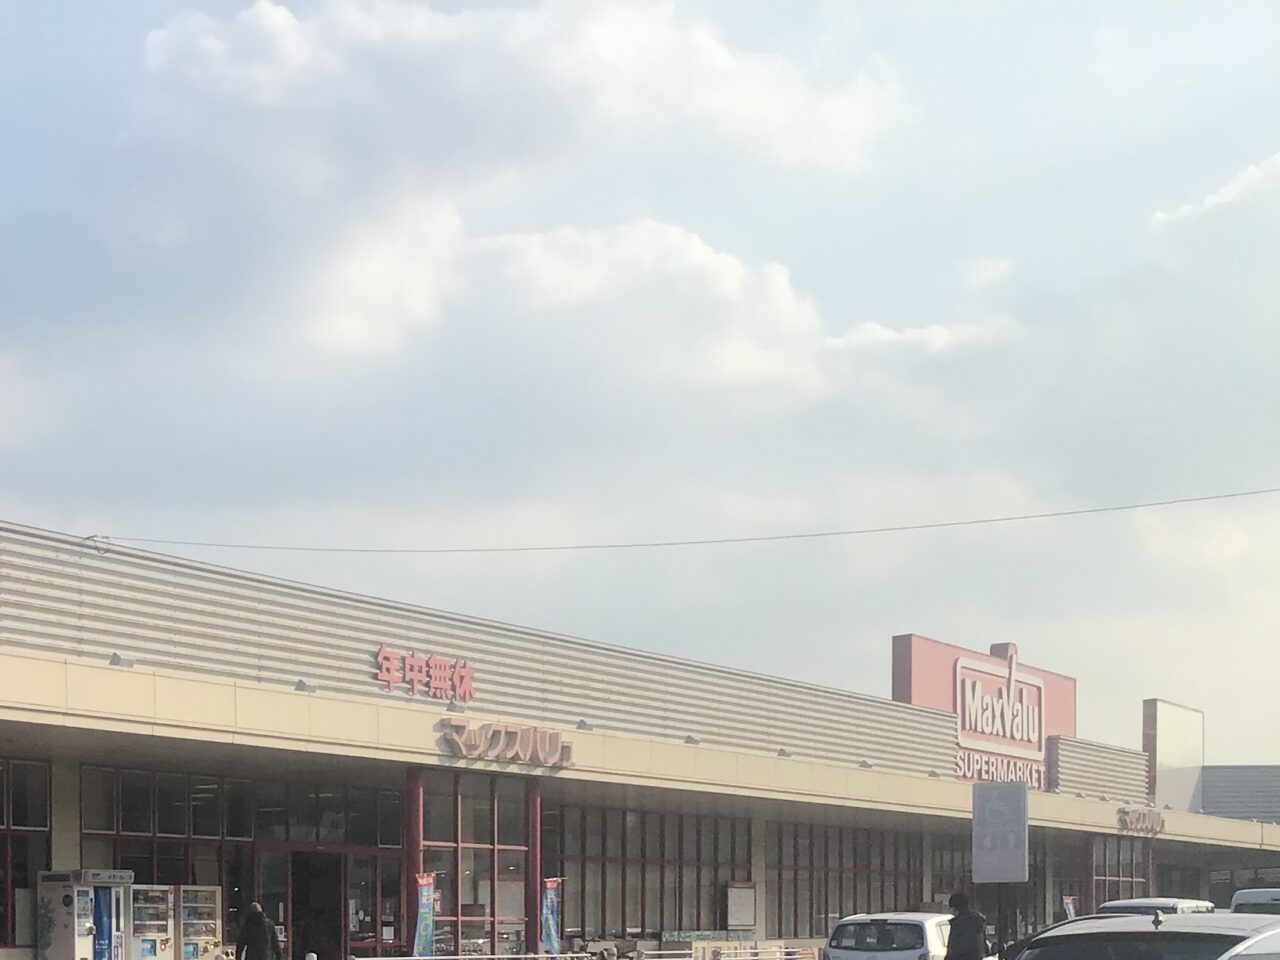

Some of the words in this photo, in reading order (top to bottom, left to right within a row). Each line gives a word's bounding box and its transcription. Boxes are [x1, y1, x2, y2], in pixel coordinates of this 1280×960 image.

[377, 642, 476, 703] 年中無休
[963, 654, 1039, 743] MaxValu
[443, 717, 576, 768] マックスバリュ
[956, 752, 1046, 790] SUPERMARKET
